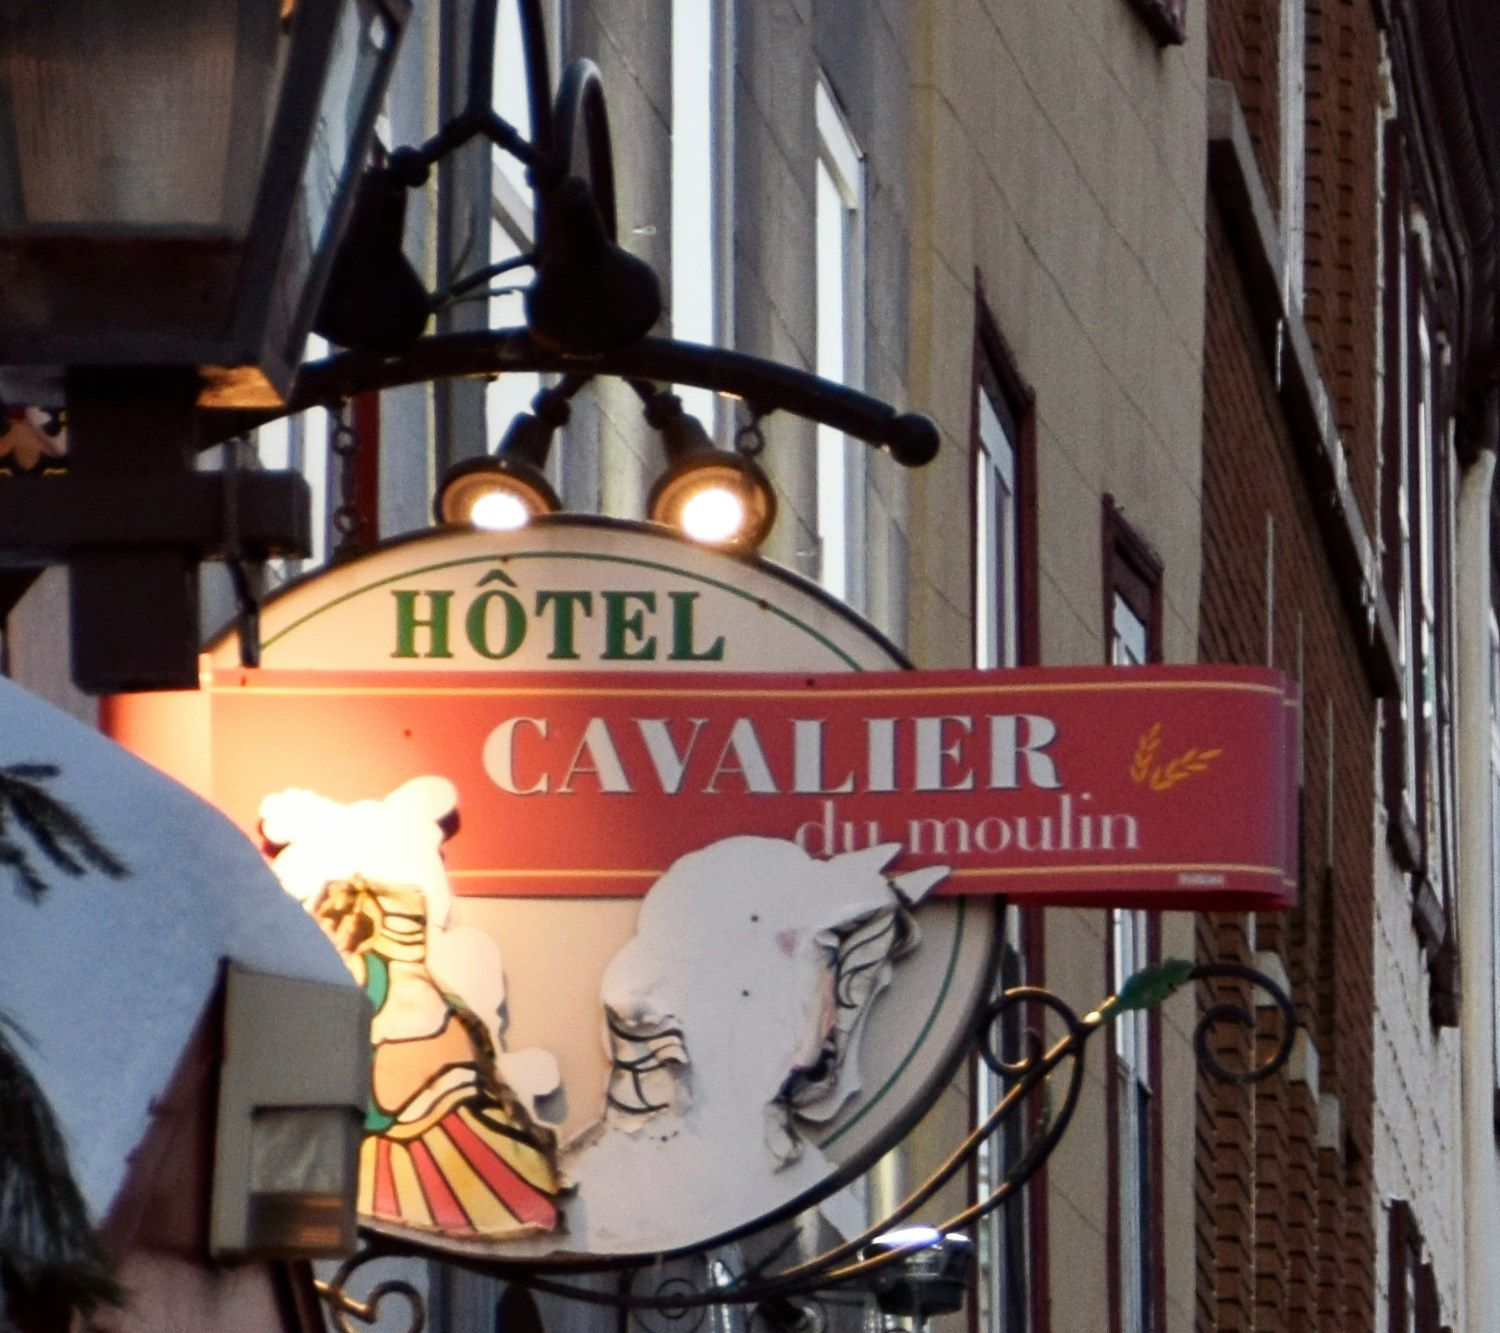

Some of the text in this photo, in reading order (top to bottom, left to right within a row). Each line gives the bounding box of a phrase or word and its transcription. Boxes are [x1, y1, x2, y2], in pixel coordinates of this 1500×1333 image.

[389, 568, 726, 661] HÔTEL
[482, 713, 1063, 797] CAVALIER
[795, 794, 1140, 858] du moulin
